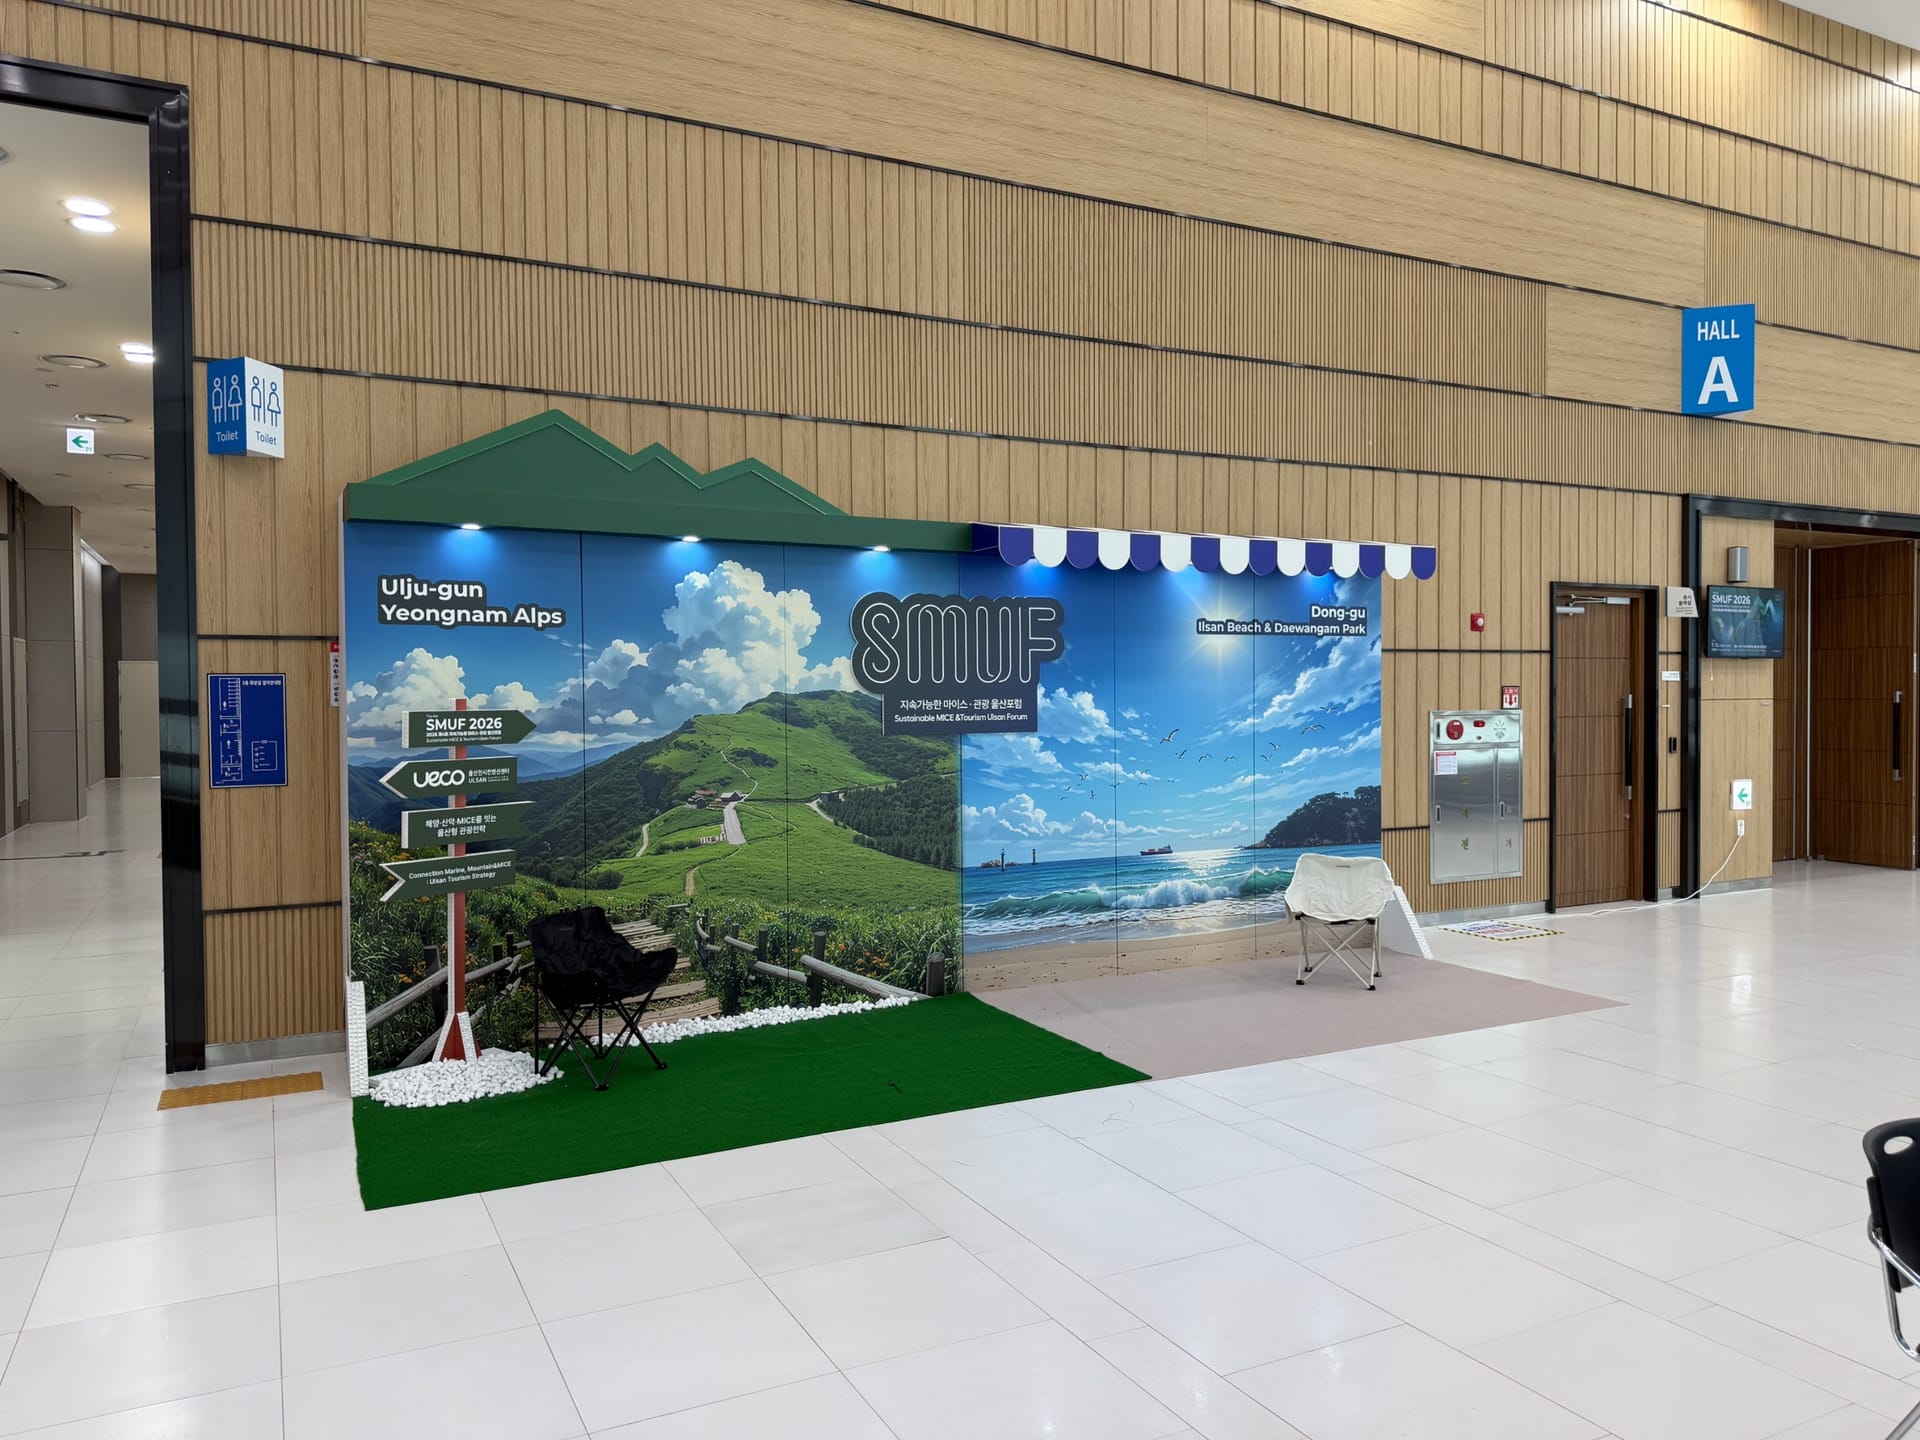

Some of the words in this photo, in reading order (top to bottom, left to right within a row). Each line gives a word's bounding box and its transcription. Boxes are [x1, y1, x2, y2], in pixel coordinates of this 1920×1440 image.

[1697, 319, 1740, 342] HALL
[1697, 356, 1739, 405] A
[216, 430, 239, 442] Toilet
[255, 430, 277, 446] Toilet
[381, 578, 483, 600] Ulju-gun
[1711, 594, 1732, 604] SMUF
[1733, 595, 1751, 604] 2026
[381, 604, 507, 626] Yeongnam
[513, 607, 563, 627] Alps
[1312, 606, 1366, 620] Dong-gu
[1198, 621, 1224, 633] Ilsan
[1227, 622, 1261, 633] Beach
[1264, 623, 1272, 633] &
[1275, 623, 1340, 636] Daewangam
[1343, 624, 1366, 634] Park
[861, 602, 1057, 684] SMUF
[900, 699, 942, 711] 지속가능한
[943, 699, 968, 710] 마이스
[973, 699, 989, 710] 관광
[991, 699, 1023, 710] 울산포럼
[426, 718, 466, 731] SMUF
[469, 717, 503, 729] 2026
[894, 713, 935, 722] Sustainable
[936, 713, 955, 722] MICE
[987, 712, 1006, 721] Ulsan
[1007, 712, 1028, 720] Forum
[483, 814, 497, 823] 잇는
[437, 827, 458, 838] 울산형
[408, 870, 444, 879] Connection
[444, 867, 467, 875] Marine,
[467, 860, 512, 871] Mountain&MICE
[448, 875, 471, 883] Tourism
[472, 871, 496, 879] Strategy
